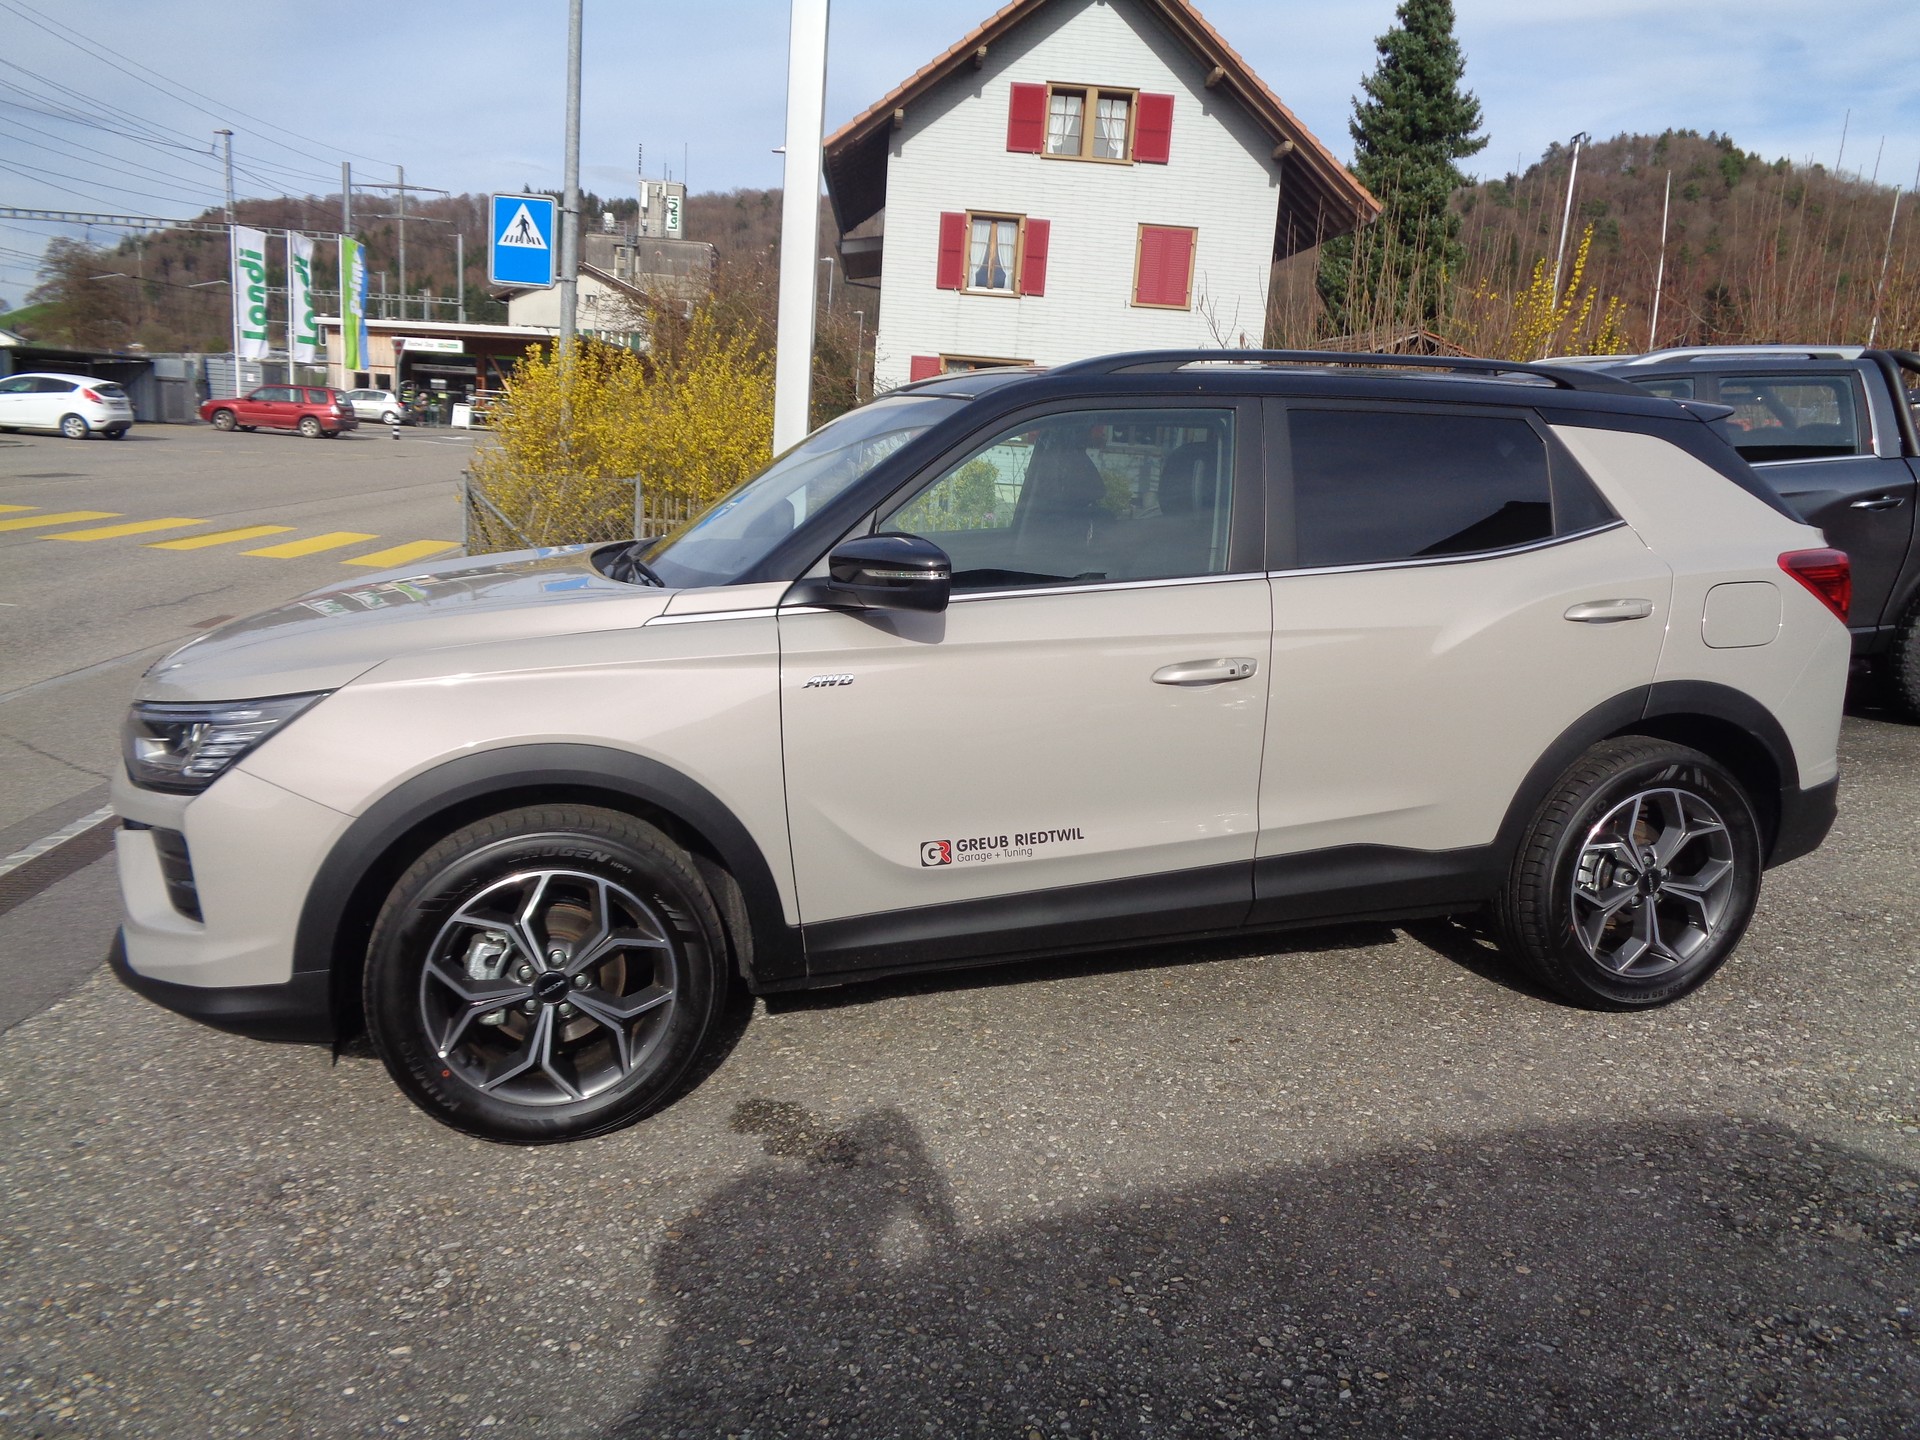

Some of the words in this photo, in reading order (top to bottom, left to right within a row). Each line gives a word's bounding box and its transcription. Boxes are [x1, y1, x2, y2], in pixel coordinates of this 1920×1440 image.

[801, 672, 855, 689] AWD
[956, 835, 1009, 852] GREUB
[1014, 827, 1085, 847] RIEDTWIL
[957, 850, 992, 862] Garage
[1003, 848, 1033, 859] Tuning
